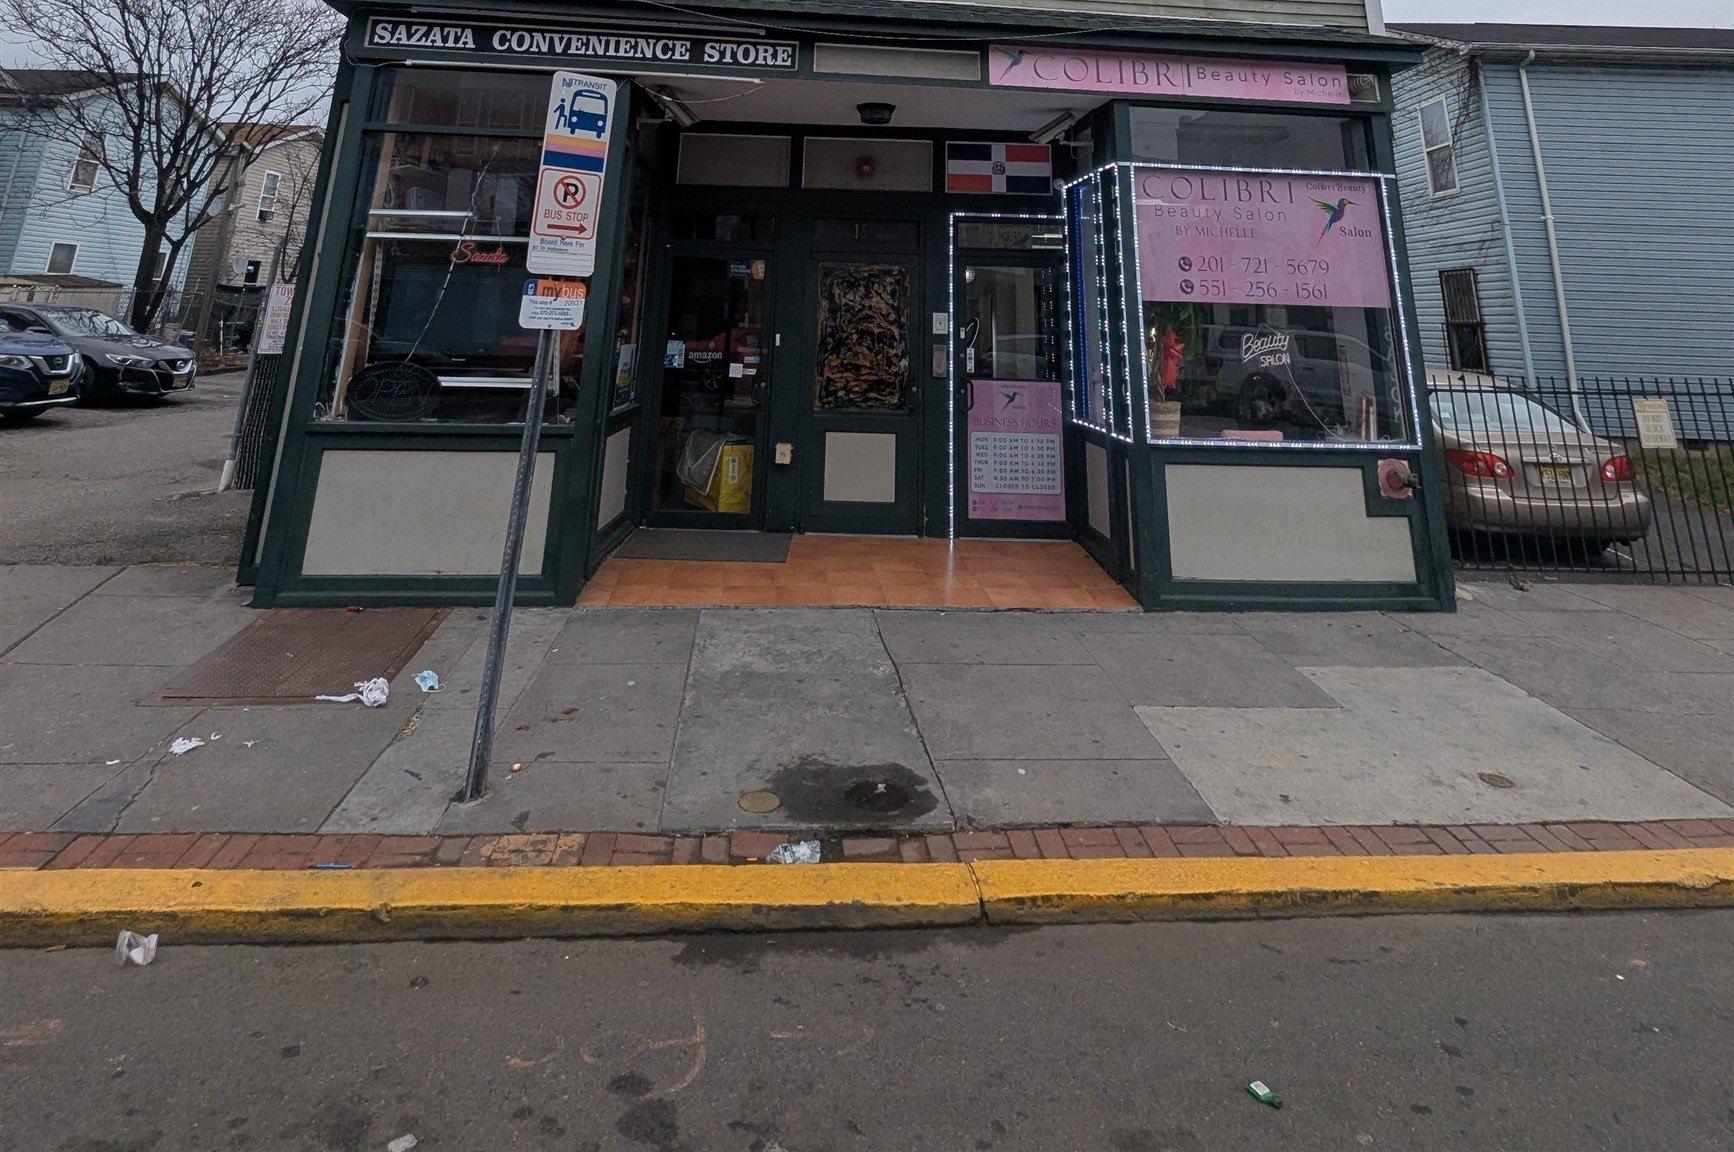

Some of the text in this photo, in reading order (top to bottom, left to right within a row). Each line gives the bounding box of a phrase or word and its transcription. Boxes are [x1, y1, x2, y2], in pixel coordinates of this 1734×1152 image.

[374, 22, 793, 67] SAZATA CONVENIENCE STORE
[1033, 54, 1193, 91] COLIBRI
[1198, 66, 1342, 88] Beauty Salon
[573, 78, 607, 91] TRANSIT
[1142, 175, 1297, 203] COLIBRI
[544, 209, 589, 223] BUS STOP
[1154, 204, 1287, 222] Beauty Salon
[1176, 225, 1257, 239] BY MICHELLE
[1339, 226, 1372, 238] Salon
[575, 240, 586, 248] For
[1197, 256, 1224, 272] 201
[1241, 257, 1268, 274] 721
[1286, 259, 1329, 276] 5679
[1200, 280, 1226, 296] 551
[1244, 281, 1277, 298] 256
[1296, 283, 1328, 299] 1561
[1242, 332, 1290, 359] Beauty
[688, 351, 723, 359] amazon
[1260, 353, 1291, 367] SALON
[973, 417, 1057, 428] BUSINESS HOURS
